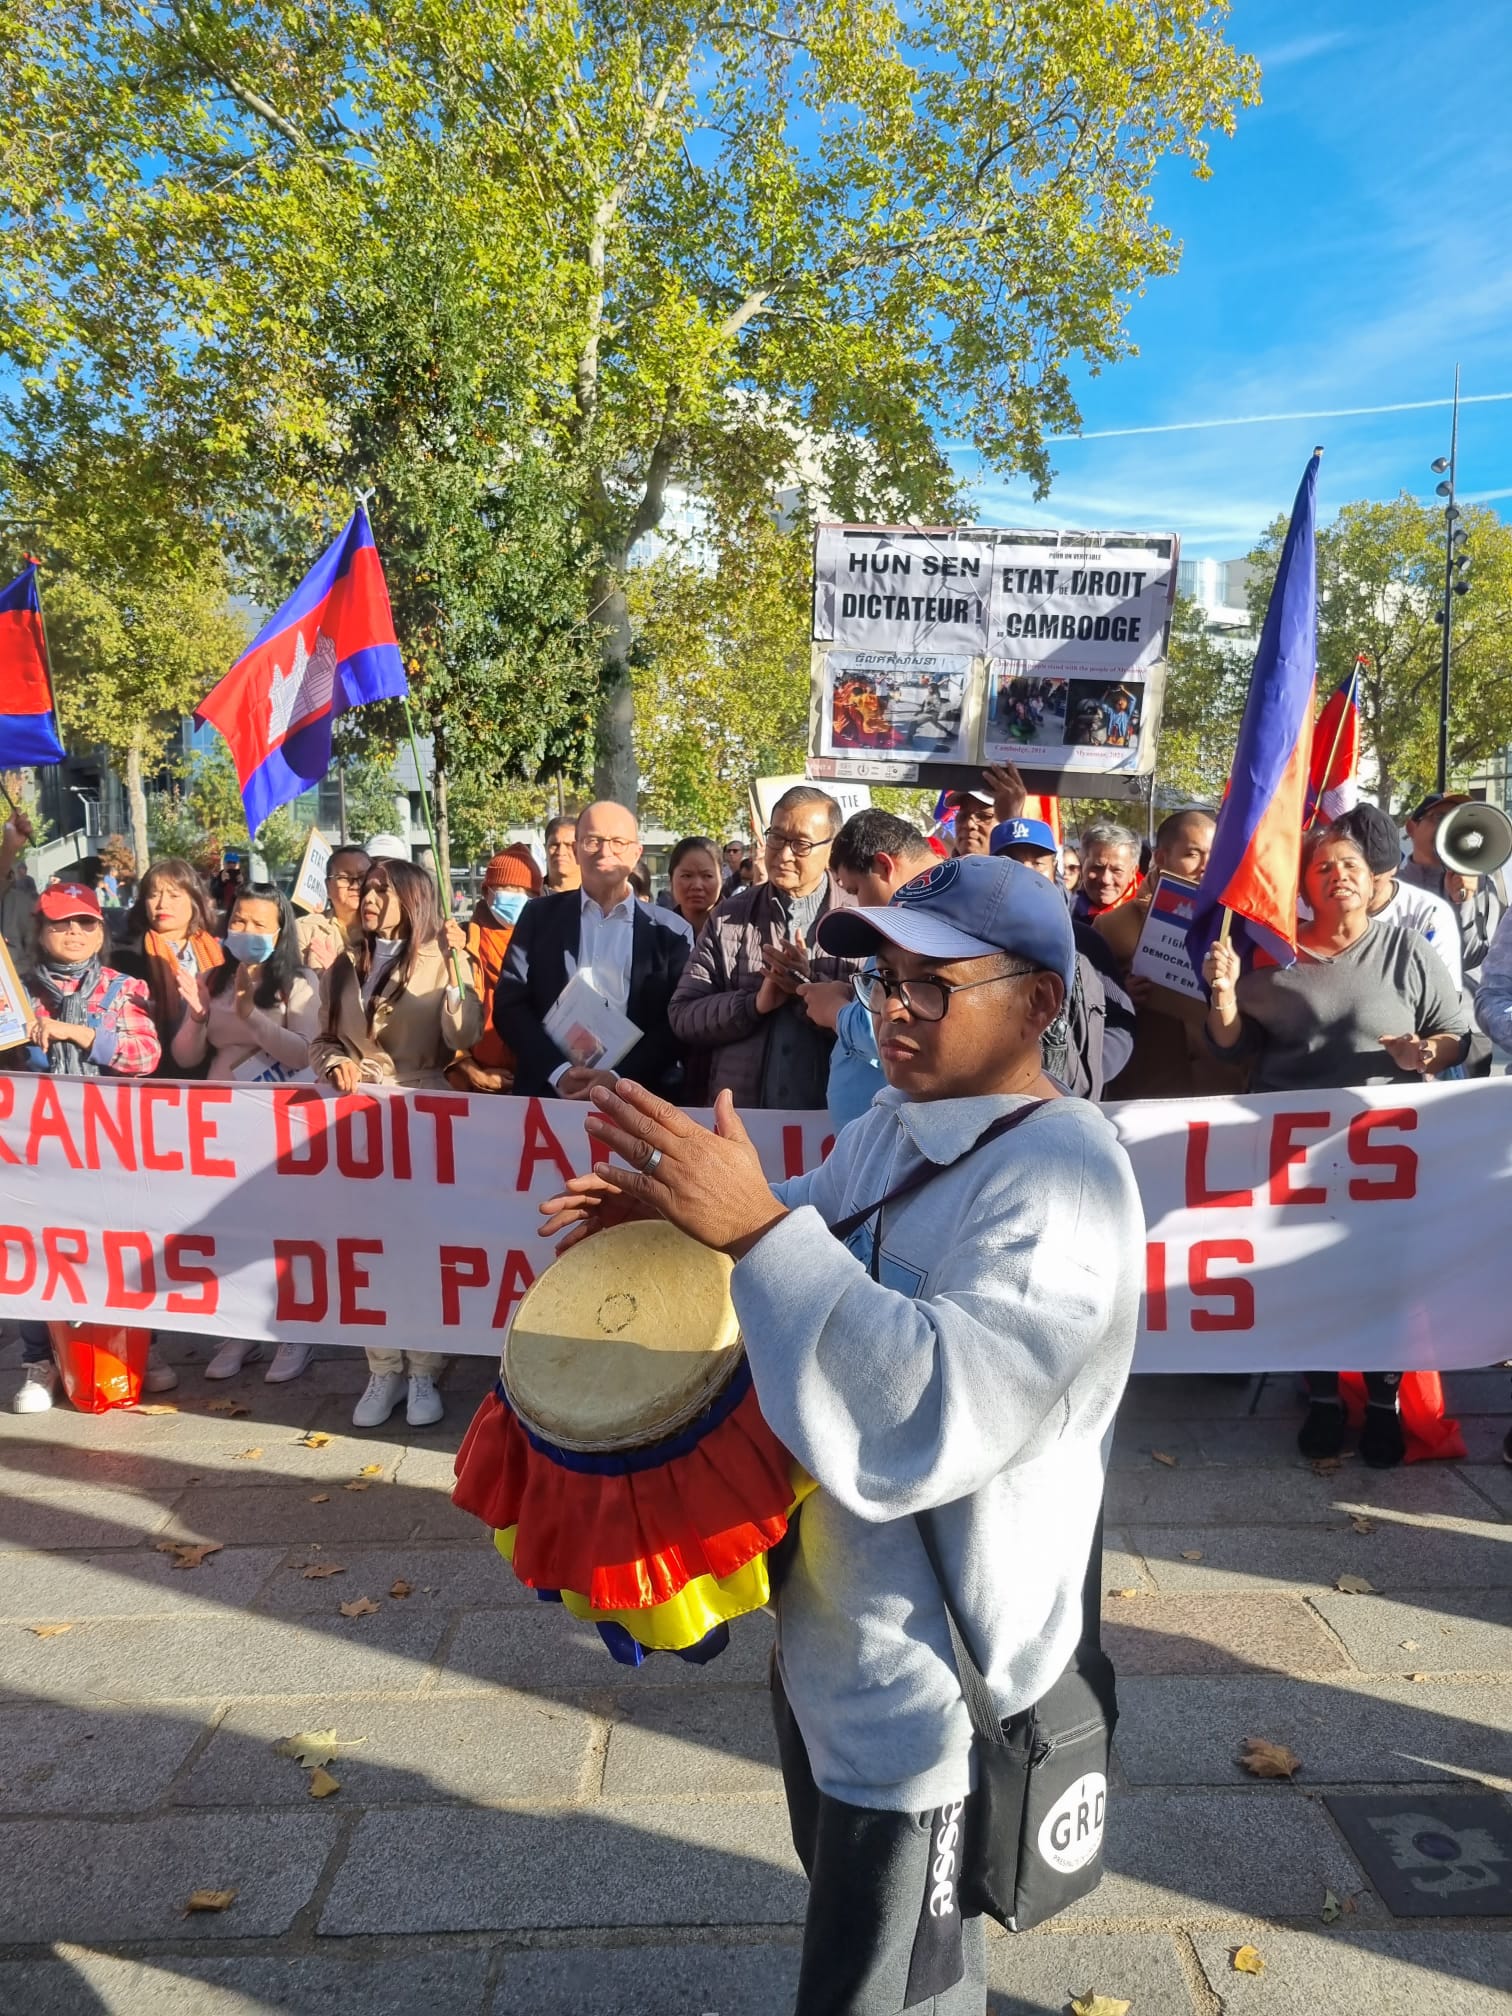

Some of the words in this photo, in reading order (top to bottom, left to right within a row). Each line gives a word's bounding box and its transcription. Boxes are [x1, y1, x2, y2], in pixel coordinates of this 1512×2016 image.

[849, 552, 911, 575] HUN
[922, 555, 980, 578] SEN
[1002, 567, 1059, 595] ETAT
[1070, 570, 1147, 598] DROIT
[842, 593, 970, 624] DICTATEUR
[975, 600, 983, 625] !
[1006, 612, 1141, 643] CAMBODGE
[1012, 821, 1029, 838] LA
[1142, 945, 1194, 971] DEMOCRA
[273, 1087, 469, 1184] DOIT
[1185, 1107, 1418, 1208] LES
[273, 1238, 387, 1326] DE
[440, 1245, 562, 1328] PA
[1050, 1790, 1104, 1851] GRD
